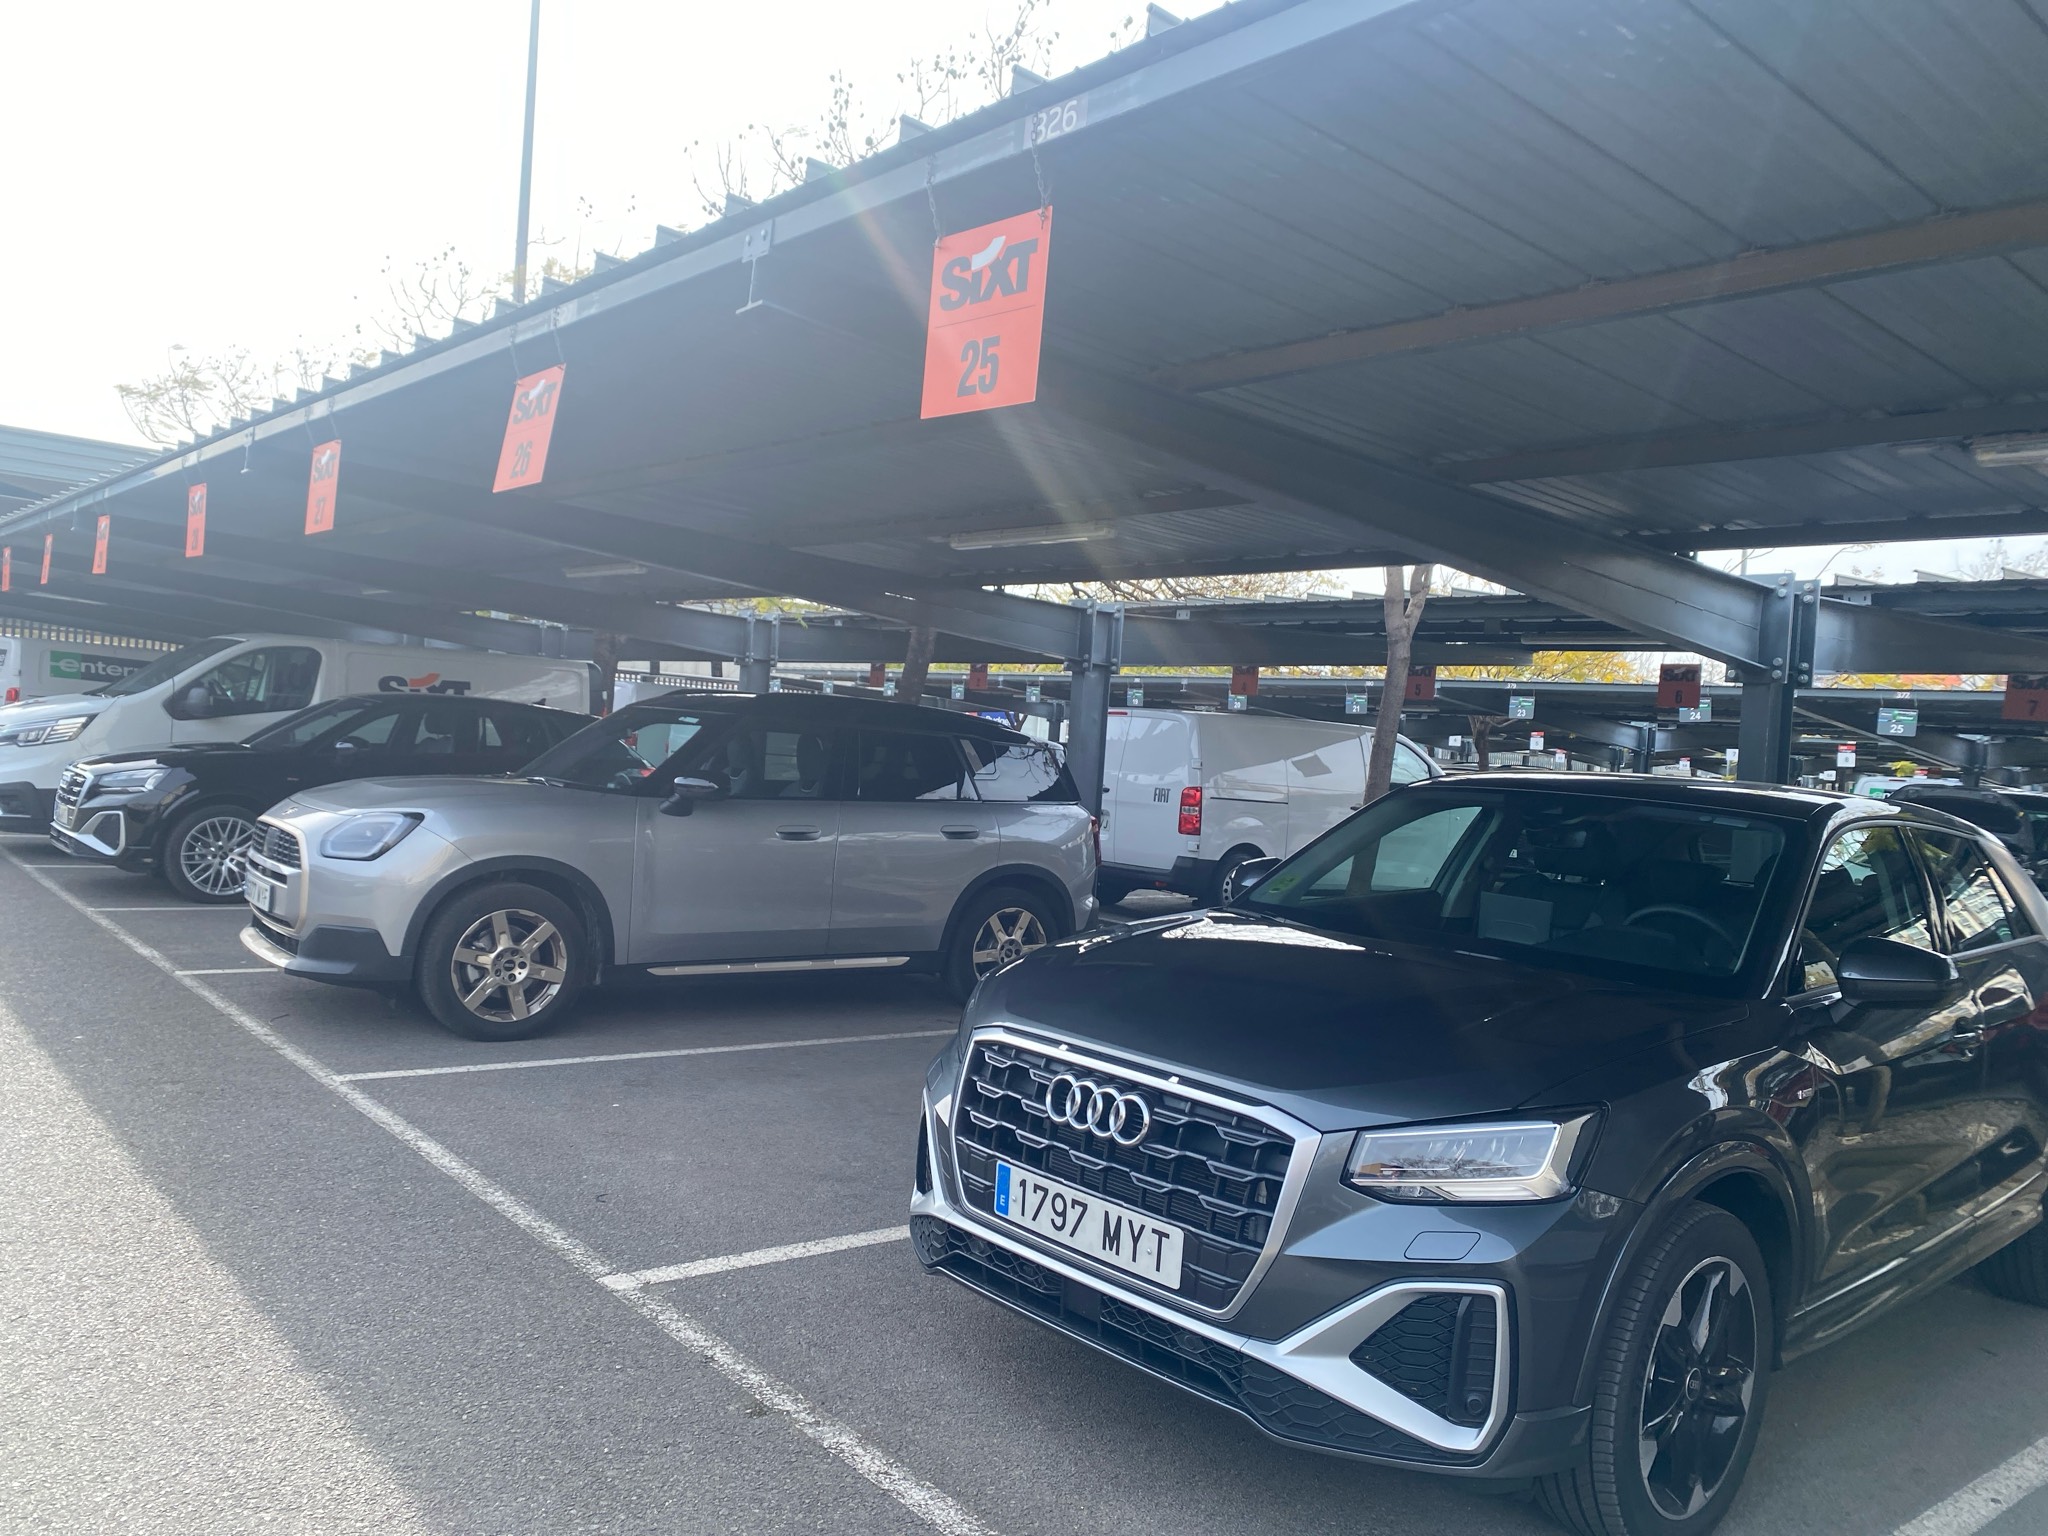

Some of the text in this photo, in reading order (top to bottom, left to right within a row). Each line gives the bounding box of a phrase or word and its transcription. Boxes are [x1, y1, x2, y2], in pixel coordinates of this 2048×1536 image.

[1035, 99, 1078, 145] 326
[939, 235, 1039, 312] SIXT
[956, 335, 1001, 399] 25
[512, 379, 558, 425] SIXT
[510, 440, 534, 480] 26
[59, 658, 138, 677] enter
[1352, 705, 1360, 713] 21
[1517, 709, 1526, 717] 23
[1689, 711, 1701, 720] 24
[2028, 700, 2038, 716] 7
[1889, 724, 1904, 734] 25
[1153, 787, 1171, 803] FIAT
[999, 1178, 1170, 1273] E 1797 MYT
